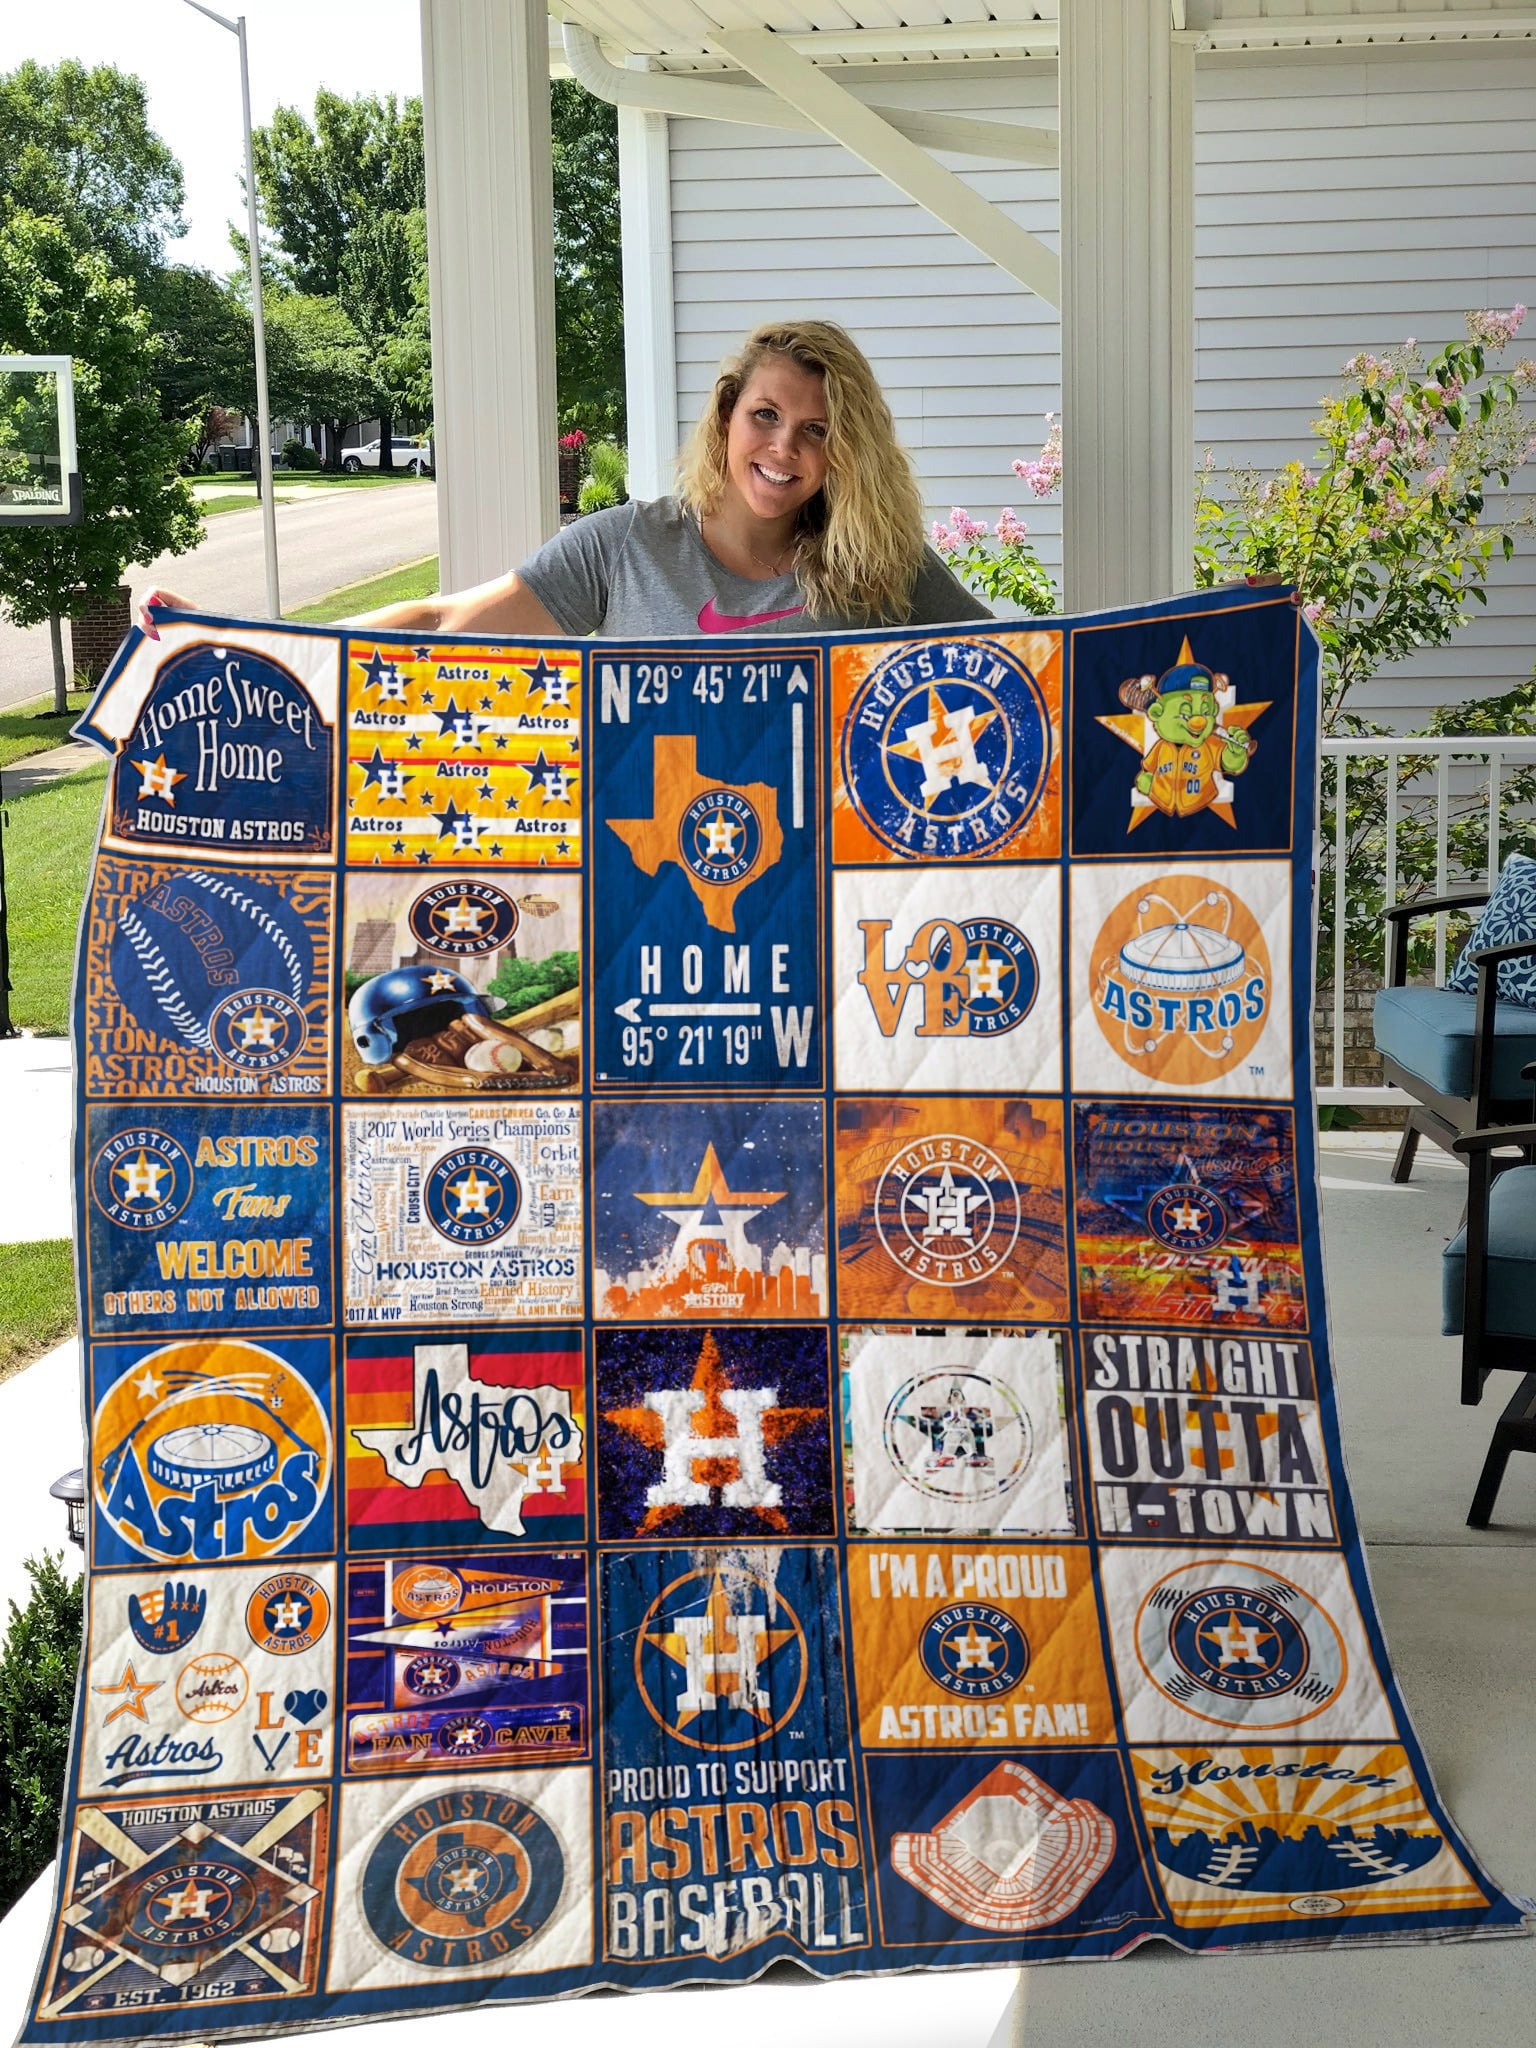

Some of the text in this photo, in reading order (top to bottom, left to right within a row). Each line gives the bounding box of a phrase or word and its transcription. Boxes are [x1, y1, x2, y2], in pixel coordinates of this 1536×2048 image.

[12, 489, 60, 501] SPALDING
[437, 666, 489, 680] Astros
[601, 664, 630, 723] N
[692, 664, 732, 704] 45'
[859, 647, 1008, 731] HOUSTON
[139, 661, 316, 750] Home Sweet
[354, 710, 406, 725] Astros
[518, 714, 569, 729] Astros
[195, 720, 283, 791] Home
[437, 761, 489, 777] Astros
[1186, 779, 1200, 794] 00
[689, 795, 752, 821] HOUSTON
[896, 775, 1028, 853] ASTROS
[137, 809, 304, 841] HOUSTON ASTROS
[350, 817, 402, 832] Astros
[515, 818, 567, 833] Astros
[693, 858, 748, 880] ASTROS
[424, 885, 504, 906] HOUSTON
[143, 884, 239, 986] ASTROS
[426, 934, 499, 952] ASTROS
[641, 944, 790, 995] HOME
[223, 995, 294, 1018] HOUSTON
[1102, 977, 1265, 1032] ASTROS
[770, 1006, 814, 1068] W
[228, 1048, 289, 1067] ASTROS
[1249, 1067, 1264, 1075] TM
[195, 1076, 321, 1093] HOUSTON ASTROS
[469, 1107, 534, 1119] CARLOS CORREA
[367, 1119, 571, 1141] 2017 World Series Champions
[1099, 1121, 1258, 1140] HOUSTON
[104, 1133, 180, 1161] HOUSTON
[195, 1136, 318, 1166] ASTROS
[541, 1144, 580, 1160] Orbit
[437, 1152, 509, 1179] HOUSTON
[892, 1142, 1001, 1182] HOUSTON
[213, 1183, 291, 1220] Fans
[407, 1165, 420, 1223] CRUSH CITY
[540, 1184, 575, 1200] Earn
[1157, 1190, 1216, 1208] HOUSTON
[108, 1202, 177, 1225] ASTROS
[441, 1219, 504, 1240] ASTROS
[1161, 1232, 1215, 1248] ASTROS
[156, 1239, 312, 1279] WELCOME
[465, 1250, 489, 1260] GEORGE
[900, 1245, 998, 1279] ASTROS
[376, 1258, 575, 1281] HOUSTON ASTROS
[104, 1286, 319, 1315] OTHERS NOT ALLOWED
[480, 1281, 573, 1298] Earned History
[367, 1308, 379, 1320] AL
[381, 1307, 402, 1320] MVP
[410, 1300, 448, 1311] Houston
[451, 1299, 483, 1312] Strong
[516, 1305, 527, 1316] AL
[1093, 1334, 1299, 1397] STRAIGHT
[395, 1368, 577, 1489] Astros
[1097, 1395, 1318, 1484] OUTTA
[1097, 1486, 1334, 1538] H-TOWN
[260, 1577, 317, 1599] HOUSTON
[470, 1581, 552, 1594] HOUSTON
[869, 1553, 1068, 1598] I'M A PROUD
[407, 1590, 459, 1602] ASTROS
[931, 1608, 1013, 1635] HOUSTON
[1184, 1594, 1284, 1624] HOUSTON
[154, 1620, 180, 1642] #1
[264, 1633, 312, 1651] ASTROS
[484, 1618, 538, 1650] HOUSTON
[411, 1656, 453, 1670] HOUSTON
[465, 1662, 535, 1681] ASTROS
[185, 1680, 239, 1699] Astros
[940, 1672, 1014, 1694] ASTROS
[1200, 1668, 1292, 1693] ASTROS
[355, 1714, 432, 1744] ASTROS
[879, 1703, 1089, 1739] ASTROS FAN!
[372, 1725, 571, 1754] FAN CAVE
[789, 1731, 804, 1739] TM
[105, 1733, 215, 1770] Astros
[607, 1759, 846, 1803] PROUD TO SUPPORT
[1151, 1759, 1397, 1795] Houston
[122, 1800, 276, 1827] HOUSTON ASTROS
[393, 1794, 539, 1844] HOUSTON
[607, 1799, 860, 1886] ASTROS
[436, 1849, 494, 1870] HOUSTON
[143, 1866, 242, 1893] HOUSTON
[437, 1893, 489, 1911] ASTROS
[606, 1872, 864, 1959] BASEBALL
[140, 1919, 230, 1944] ASTROS
[388, 1917, 533, 1965] ASTROS
[113, 1981, 237, 2007] EST. 1962
